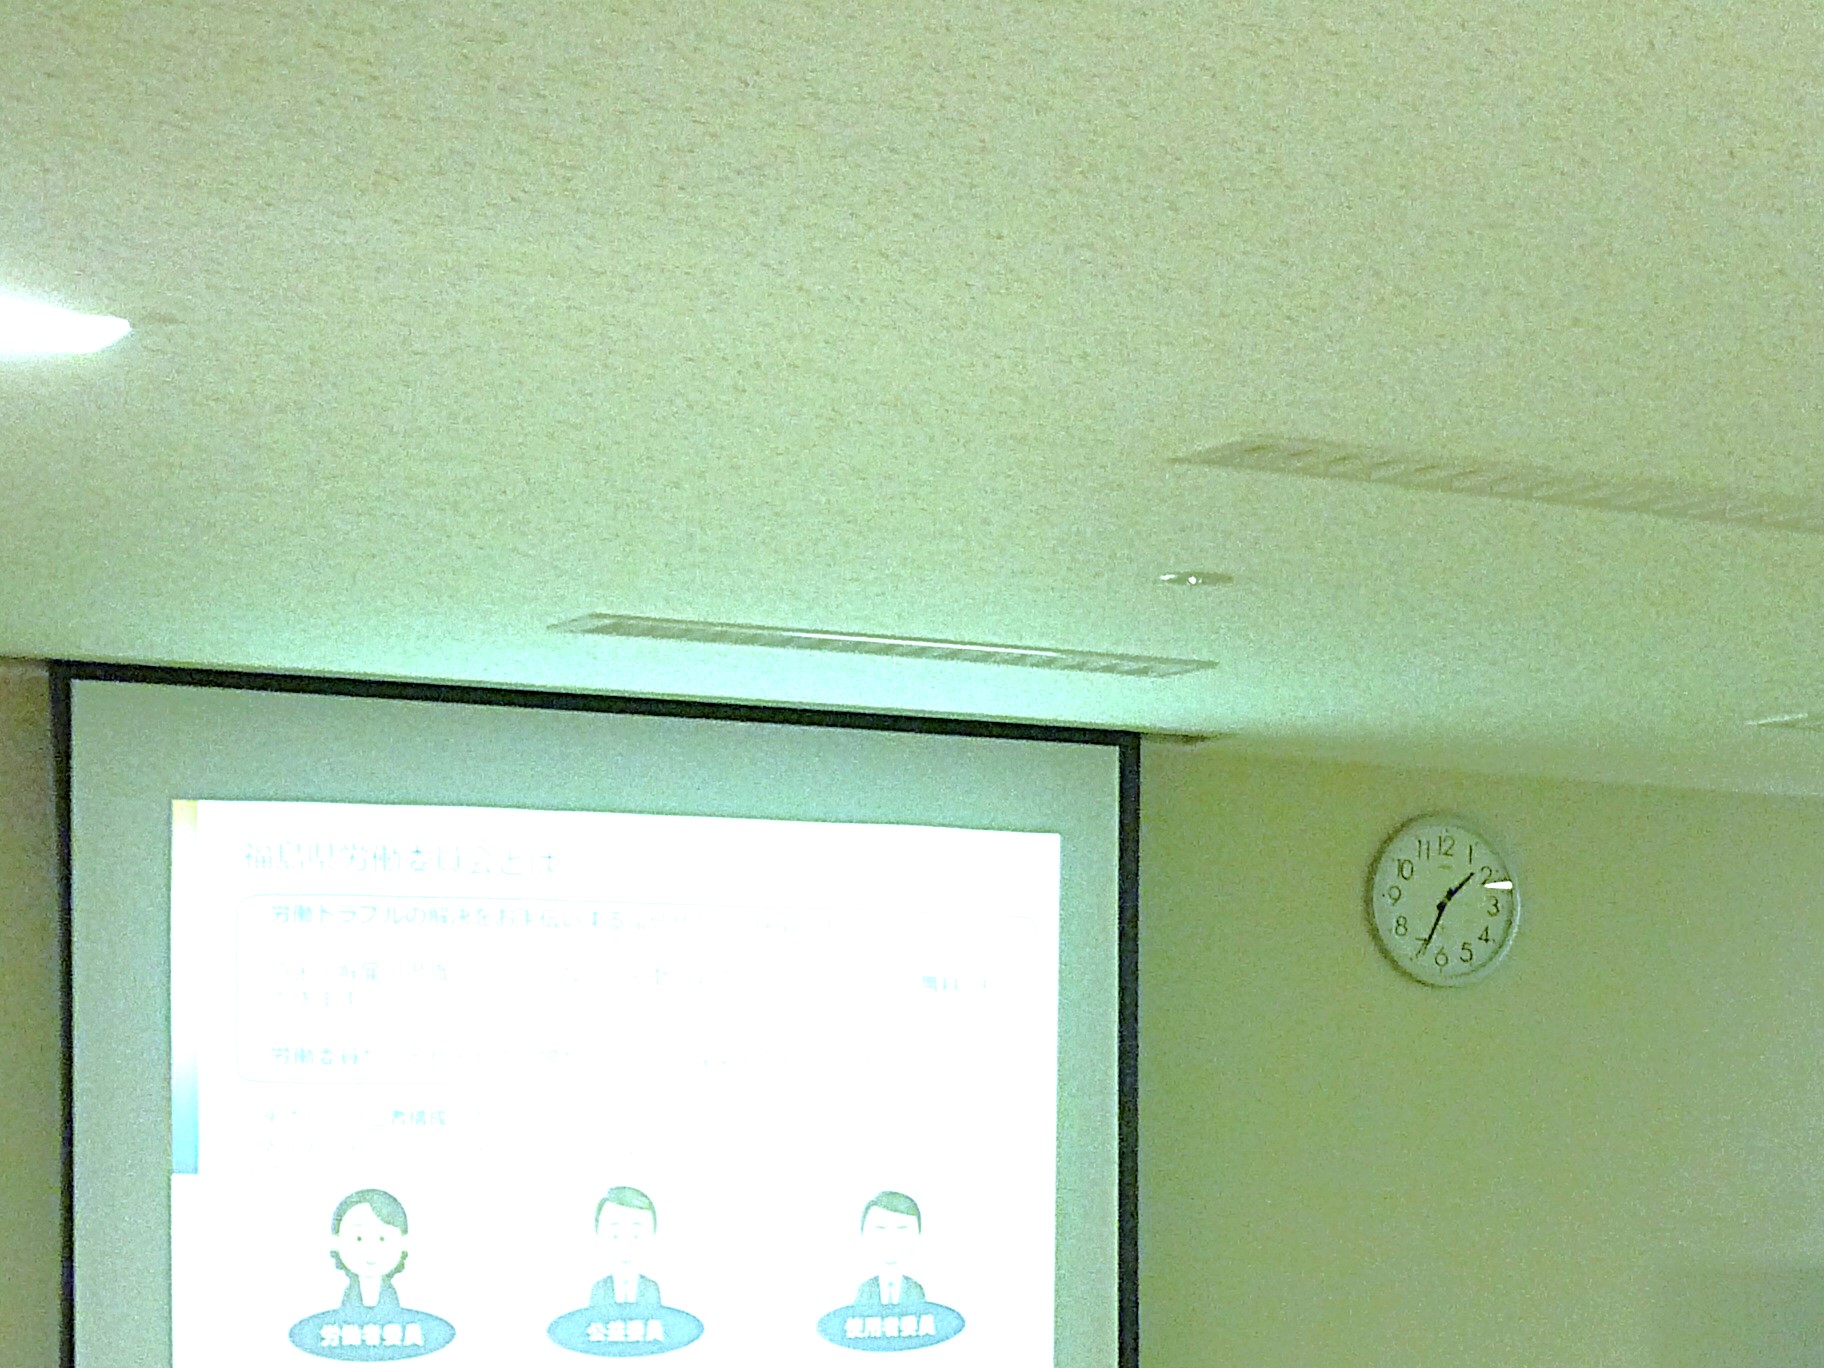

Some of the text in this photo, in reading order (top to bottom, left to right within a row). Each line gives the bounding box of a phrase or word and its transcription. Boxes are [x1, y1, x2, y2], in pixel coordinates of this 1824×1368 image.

[1417, 839, 1431, 860] 11
[1438, 835, 1455, 857] 12
[1397, 858, 1414, 880] 10
[1480, 865, 1493, 886] 2
[1387, 885, 1402, 906] 9
[1487, 895, 1500, 917] 3
[1395, 915, 1408, 937] 8
[1478, 926, 1490, 943] 4
[1415, 937, 1429, 959] 7
[1435, 945, 1449, 967] 6
[1459, 942, 1474, 963] 5
